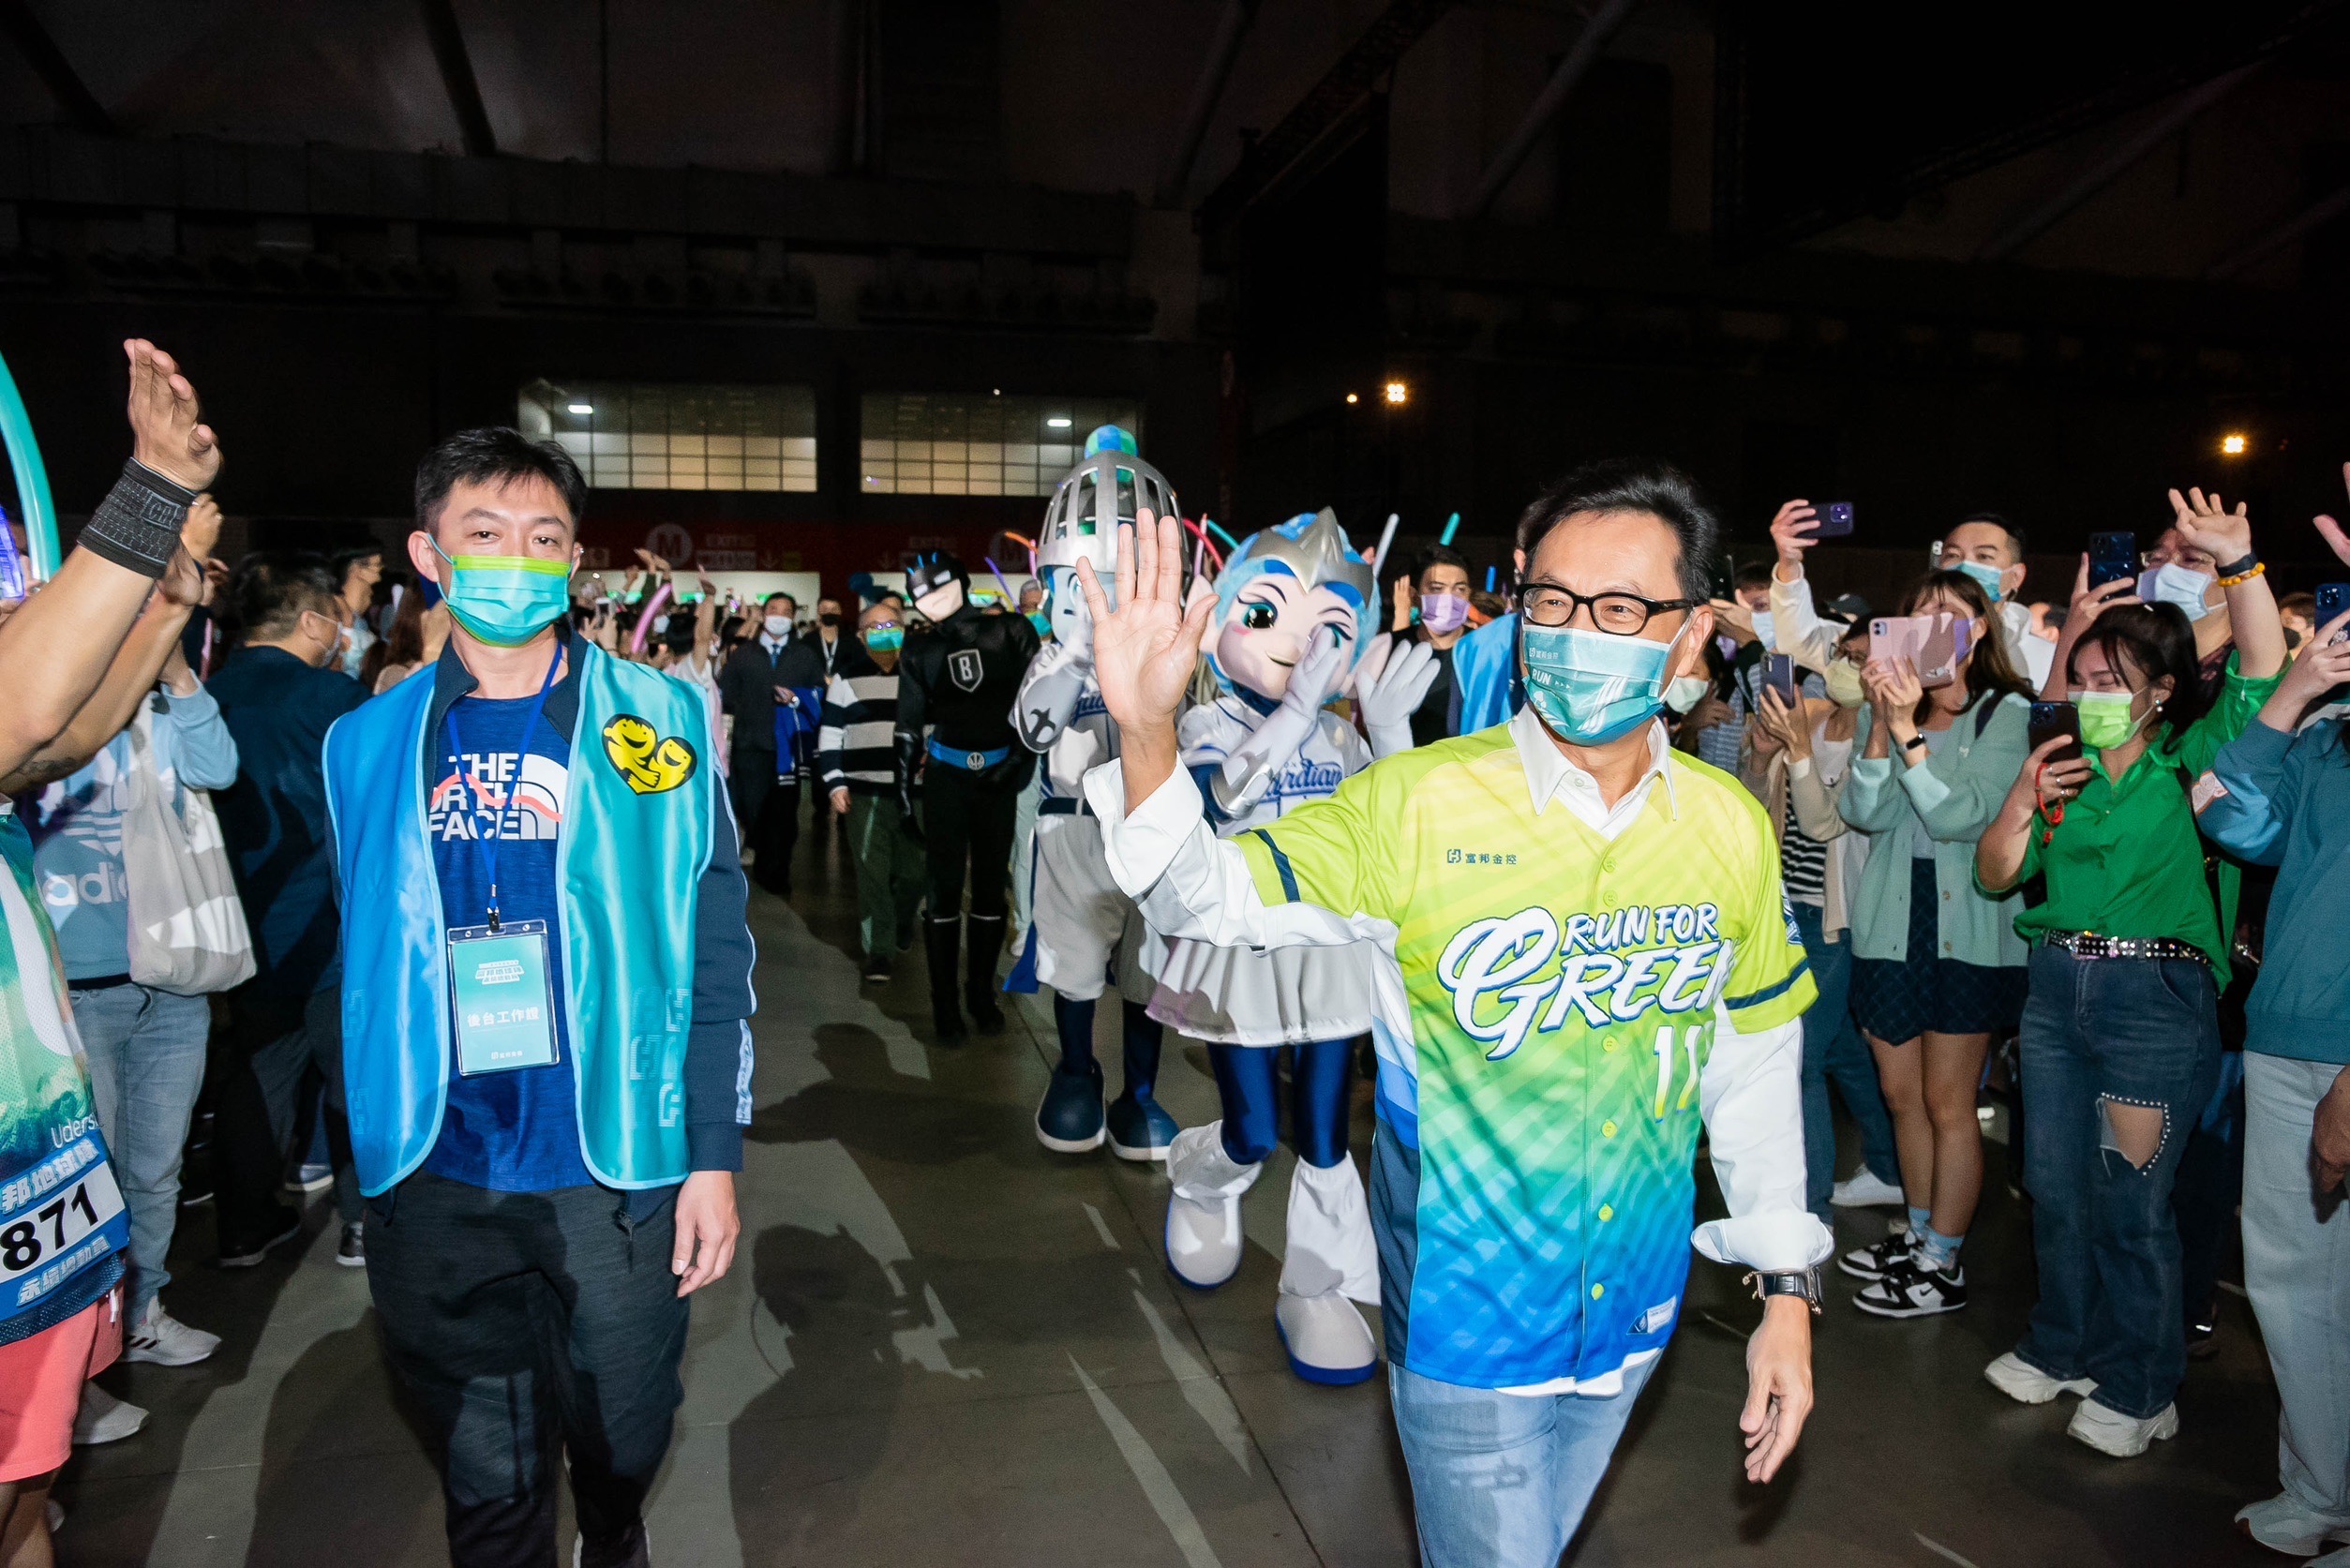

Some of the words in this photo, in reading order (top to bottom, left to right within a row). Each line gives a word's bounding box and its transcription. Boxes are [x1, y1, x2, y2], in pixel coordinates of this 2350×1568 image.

[958, 655, 974, 682] B
[1532, 668, 1551, 685] RUN
[448, 753, 519, 783] THE
[430, 782, 520, 813] RTH
[428, 810, 520, 842] FACE
[1465, 853, 1517, 865] 富邦金控
[42, 861, 128, 907] adi
[1559, 913, 1651, 956] RUN
[1653, 902, 1721, 945] FOR
[0, 1181, 99, 1272] 871
